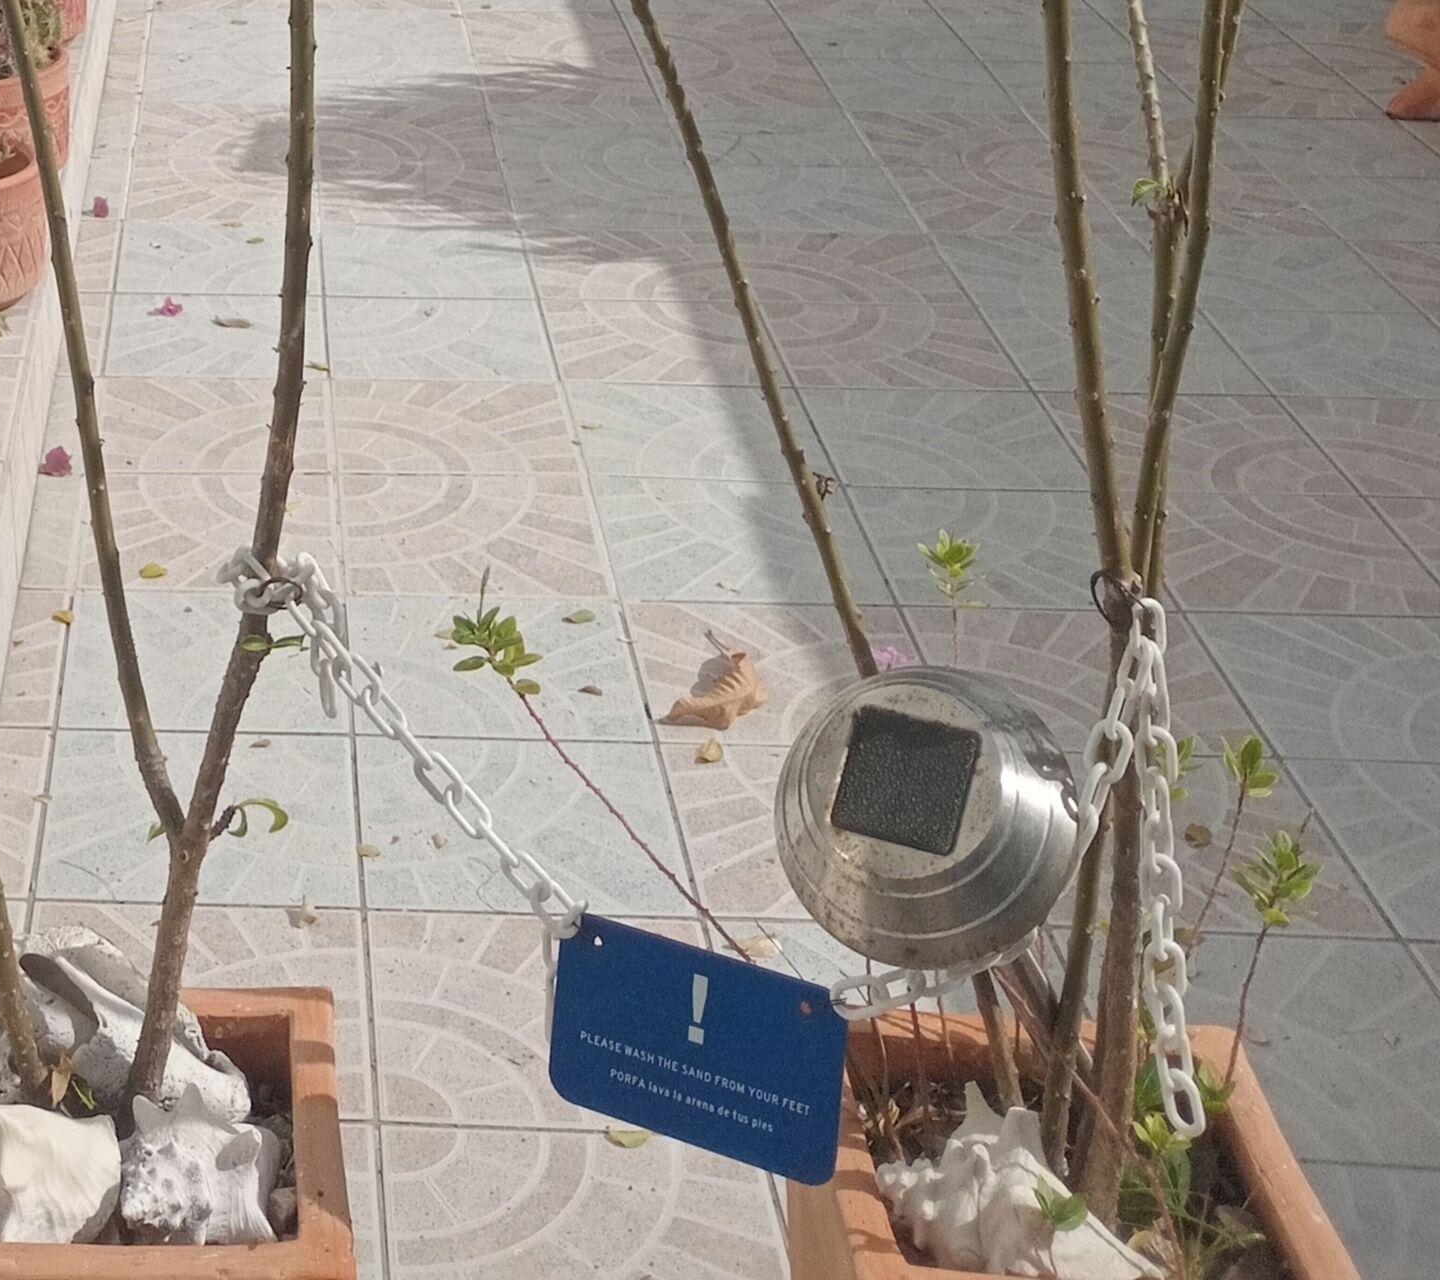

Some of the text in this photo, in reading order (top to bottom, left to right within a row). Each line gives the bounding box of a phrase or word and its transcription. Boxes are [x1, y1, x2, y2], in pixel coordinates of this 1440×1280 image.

[580, 1030, 811, 1116] PLEASE WASH THE SAND FROM YOUR FEET
[609, 1068, 774, 1133] PORFA lava la arena de tus pies
